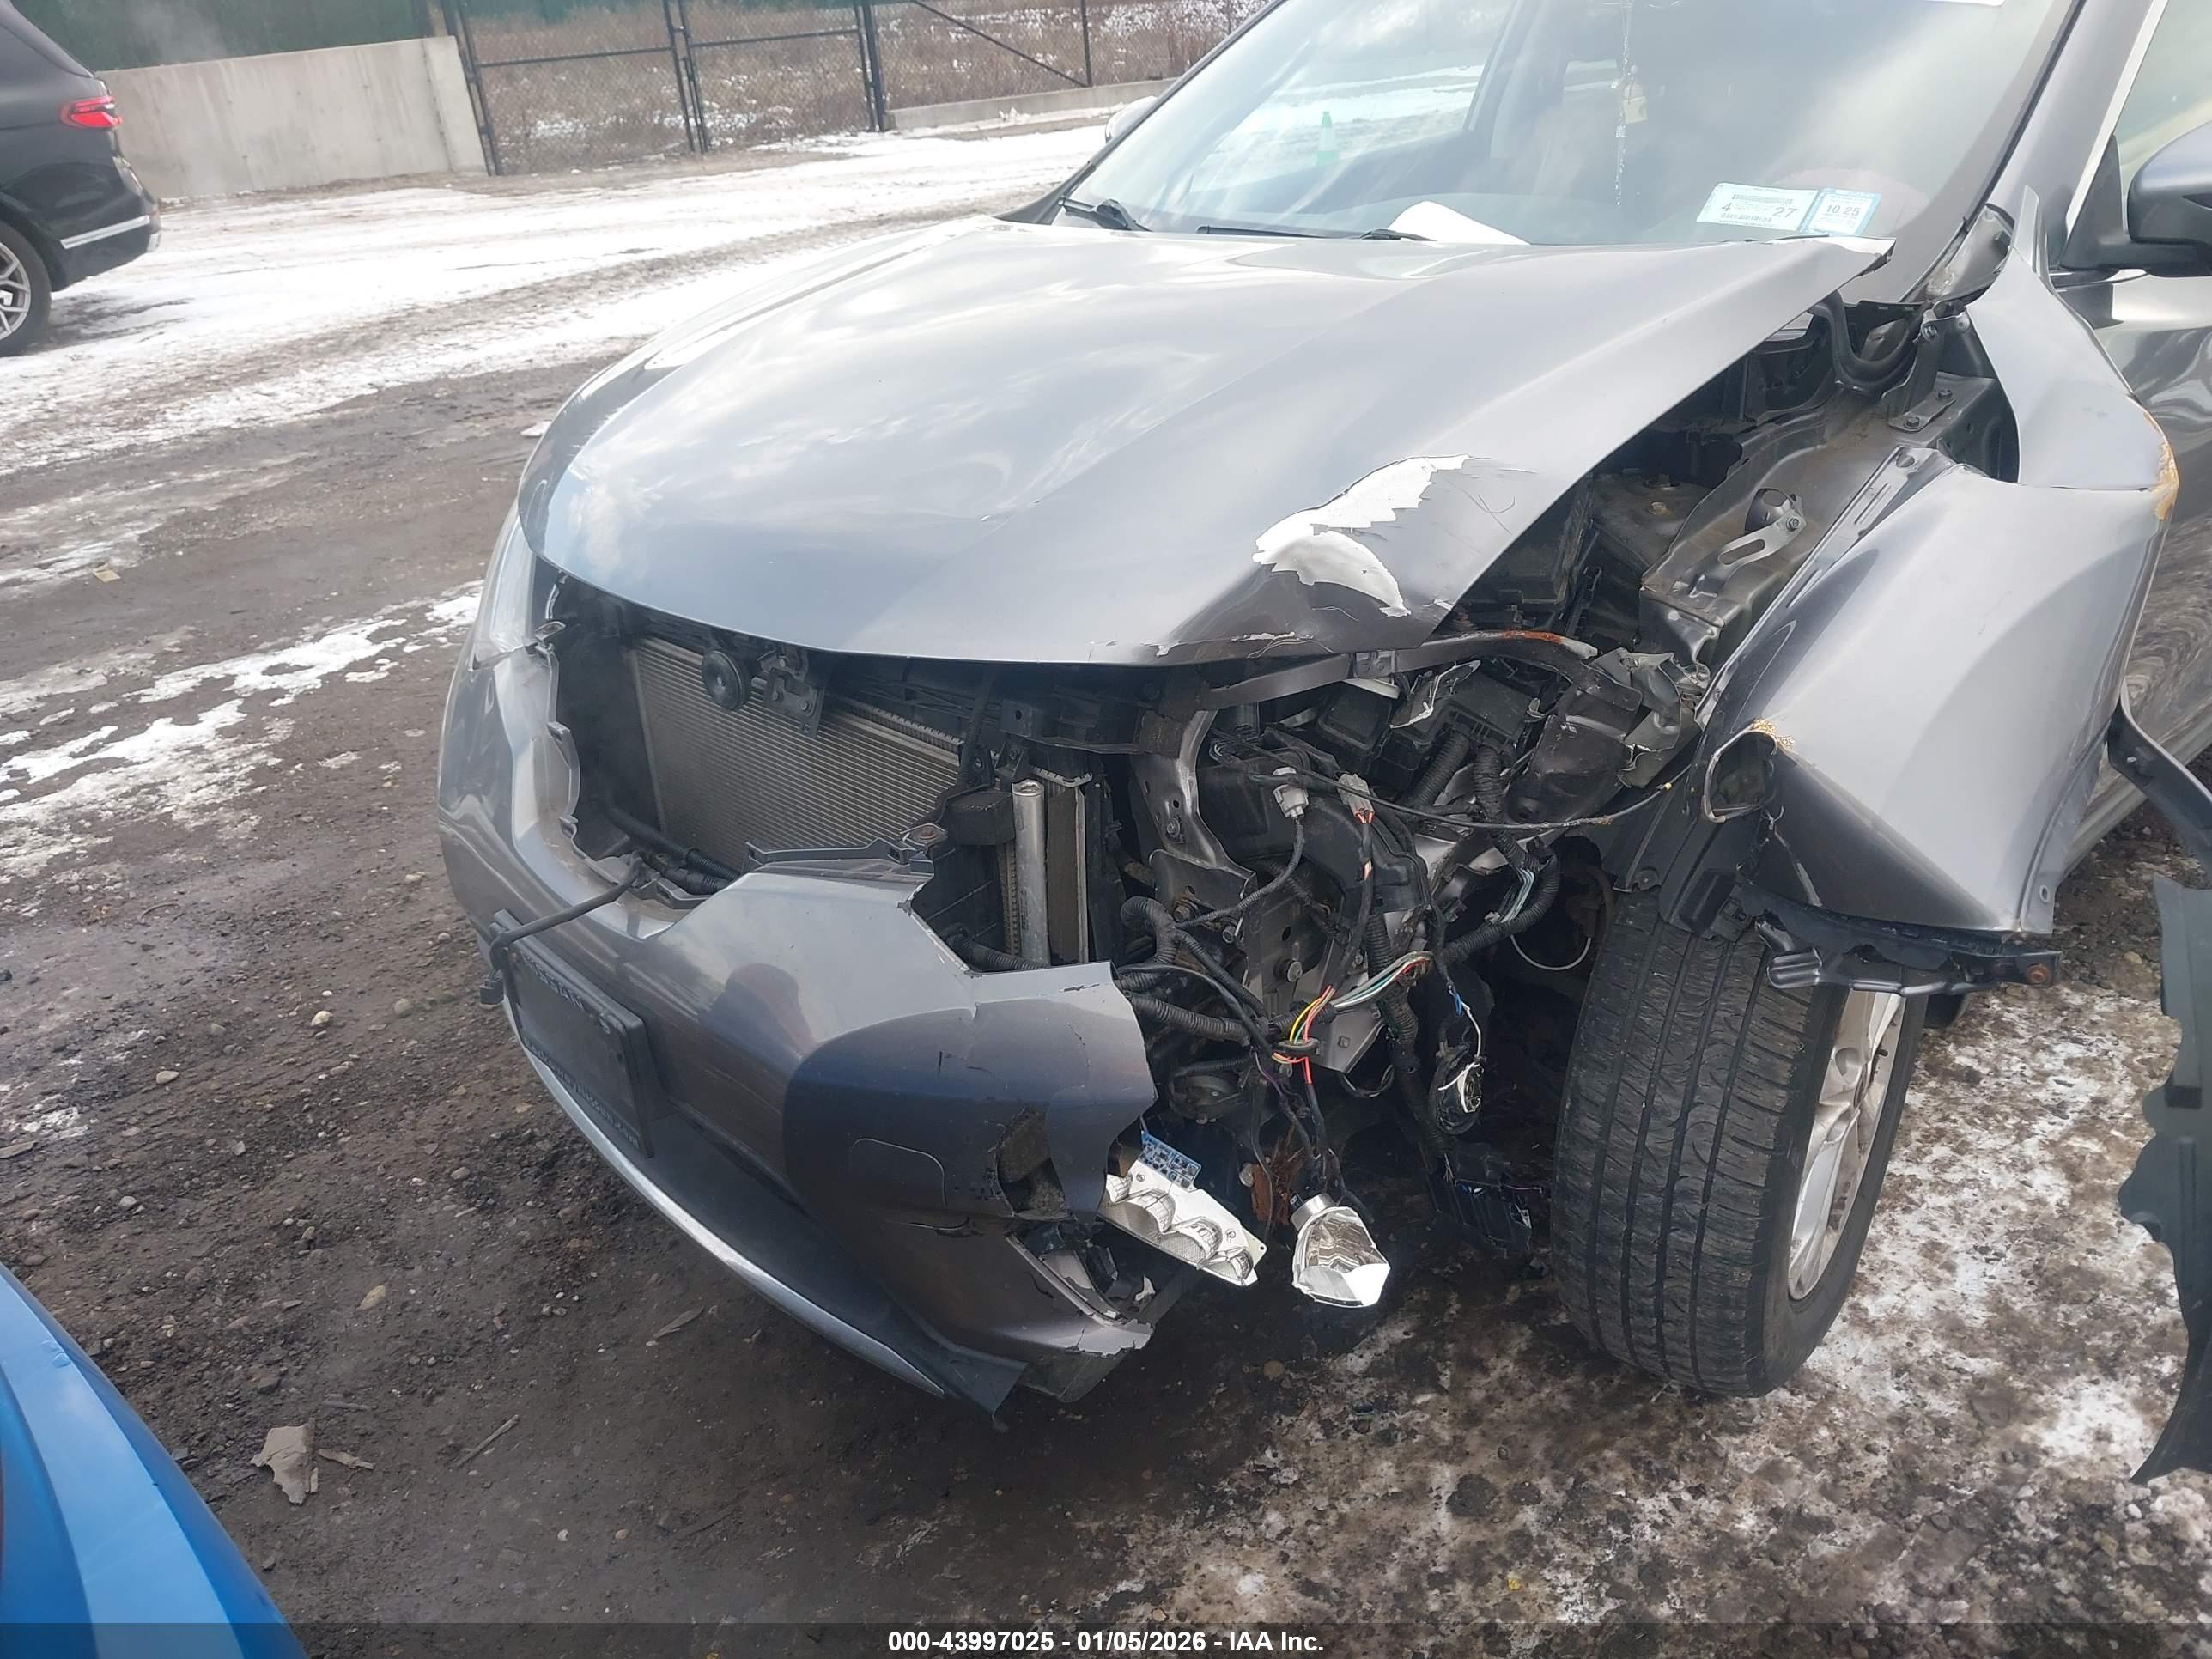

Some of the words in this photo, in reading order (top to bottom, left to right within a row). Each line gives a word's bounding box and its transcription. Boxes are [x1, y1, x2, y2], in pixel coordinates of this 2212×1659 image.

[1772, 206, 1799, 218] 27
[1826, 204, 1841, 214] 10
[1843, 206, 1861, 216] 25
